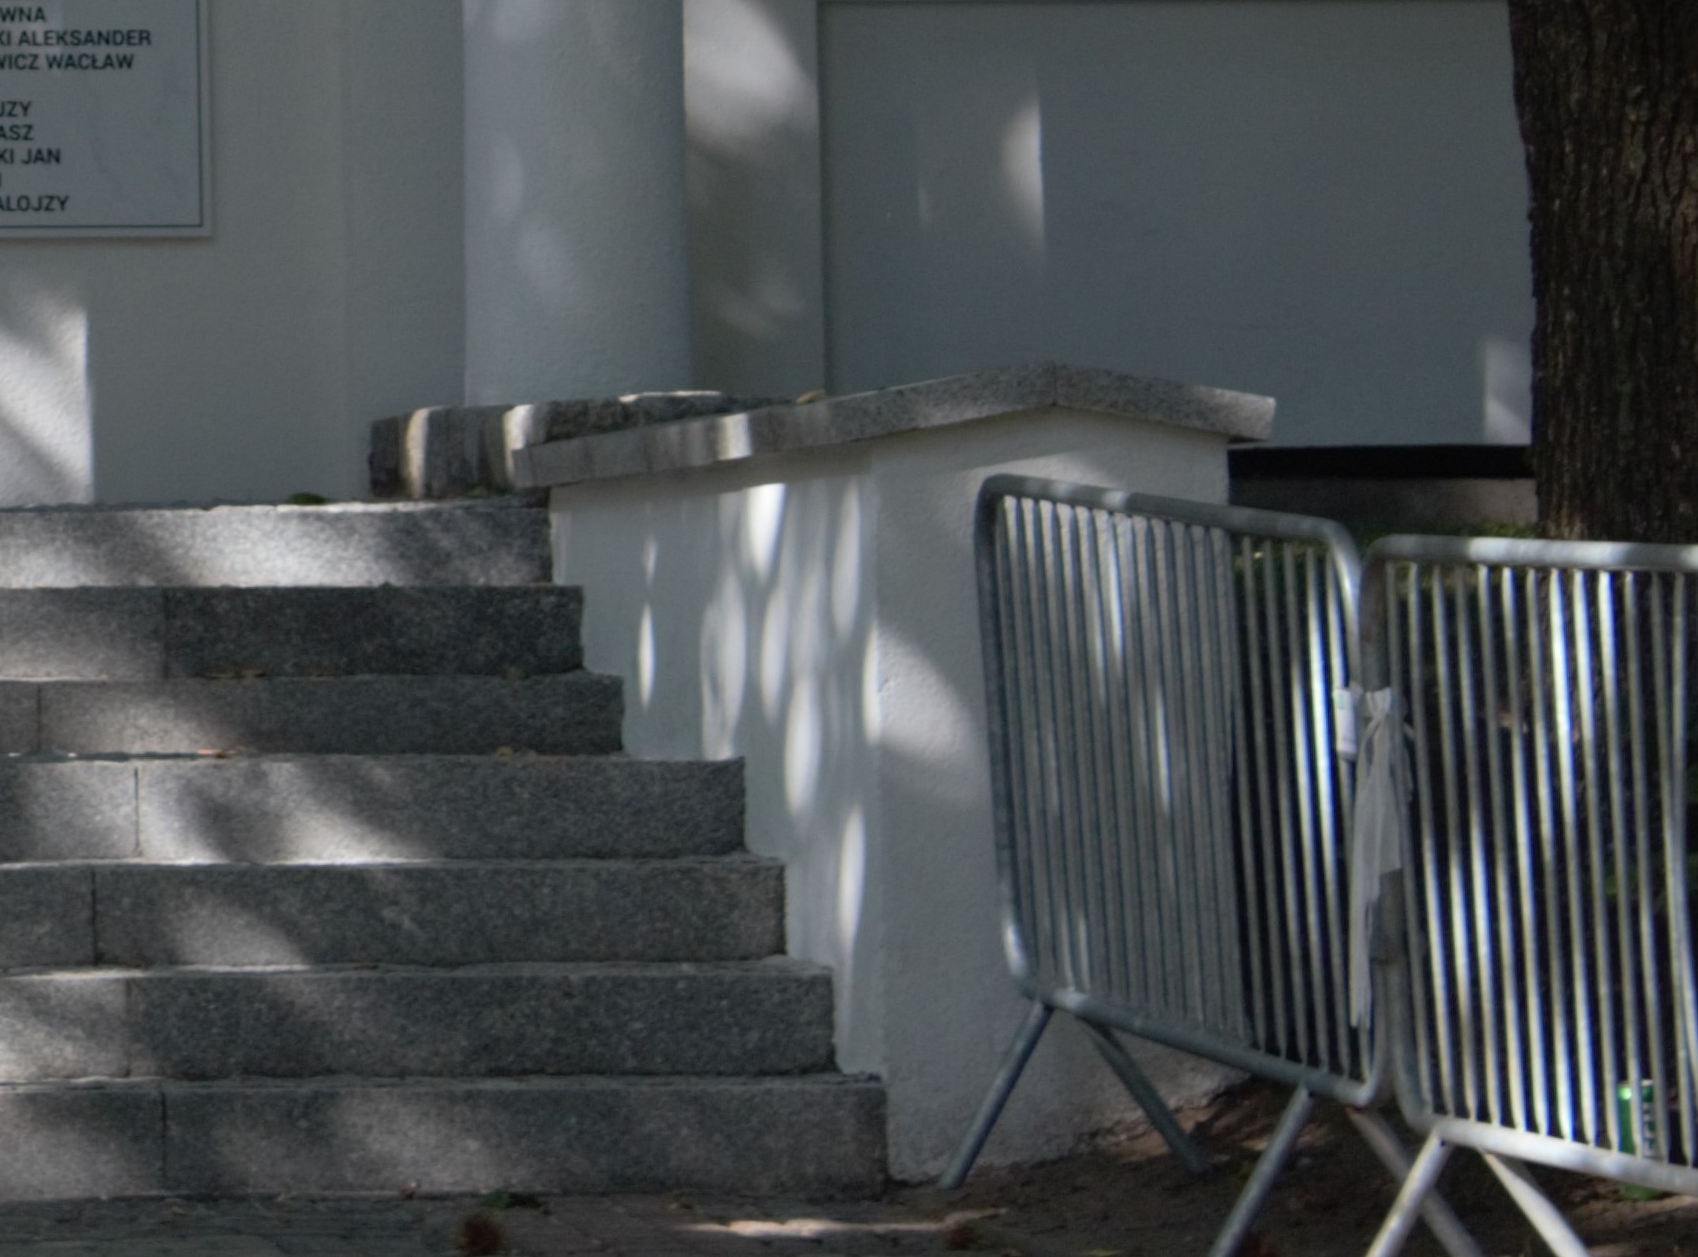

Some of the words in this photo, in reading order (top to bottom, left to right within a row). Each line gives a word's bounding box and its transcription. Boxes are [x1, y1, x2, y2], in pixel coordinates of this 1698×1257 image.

[17, 30, 152, 46] ALEKSANDER
[46, 54, 134, 70] WACŁAW
[21, 149, 61, 164] JAN
